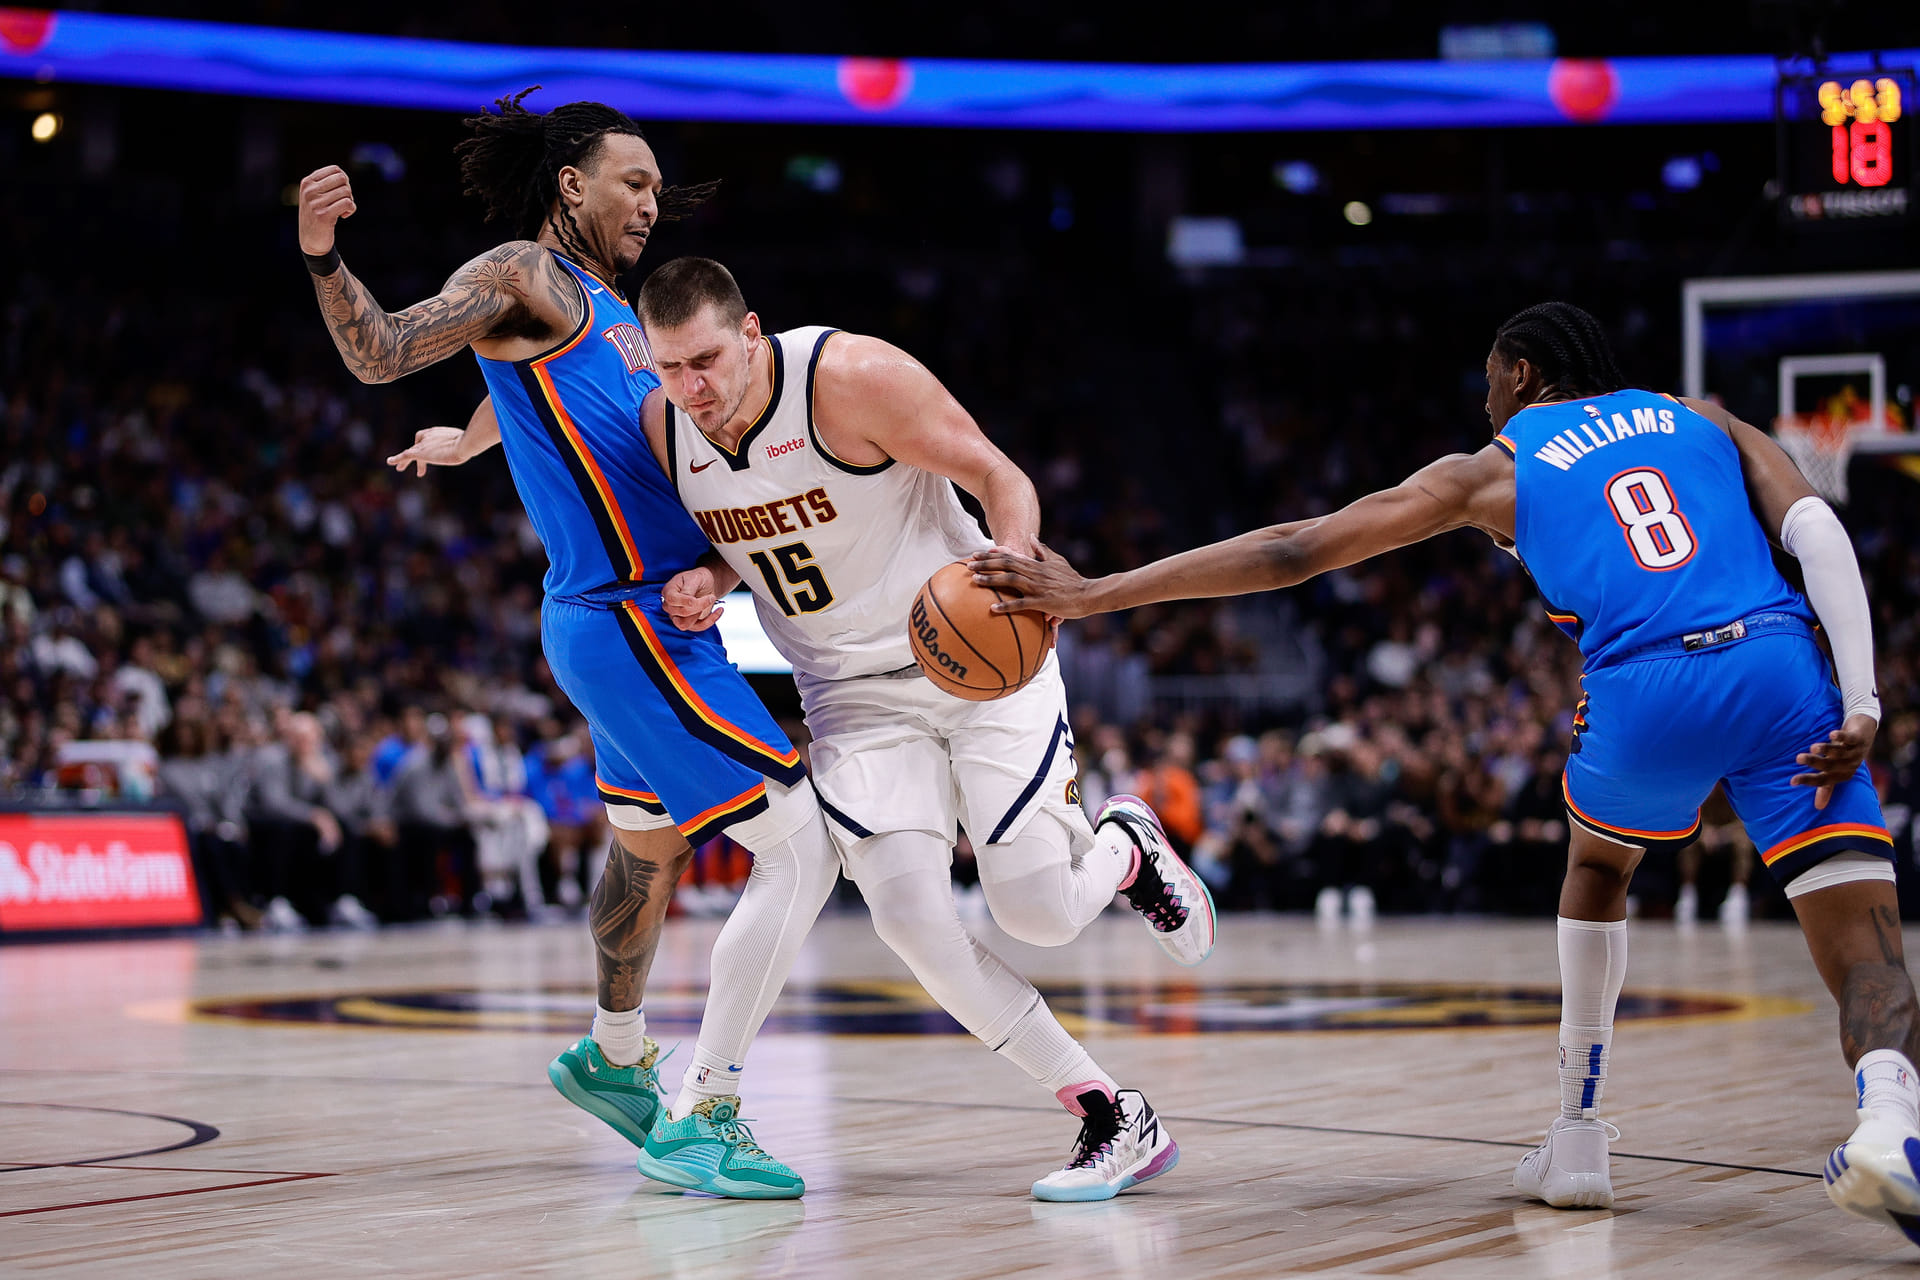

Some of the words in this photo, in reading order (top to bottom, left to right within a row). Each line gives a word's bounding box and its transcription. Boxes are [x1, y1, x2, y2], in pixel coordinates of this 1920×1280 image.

[1832, 120, 1892, 187] 18
[765, 438, 805, 459] ibotta
[1534, 407, 1675, 471] WILLIAMS
[694, 487, 838, 544] NUGGETS
[1604, 466, 1698, 572] 8
[747, 540, 834, 617] 15
[911, 594, 968, 680] Wilson
